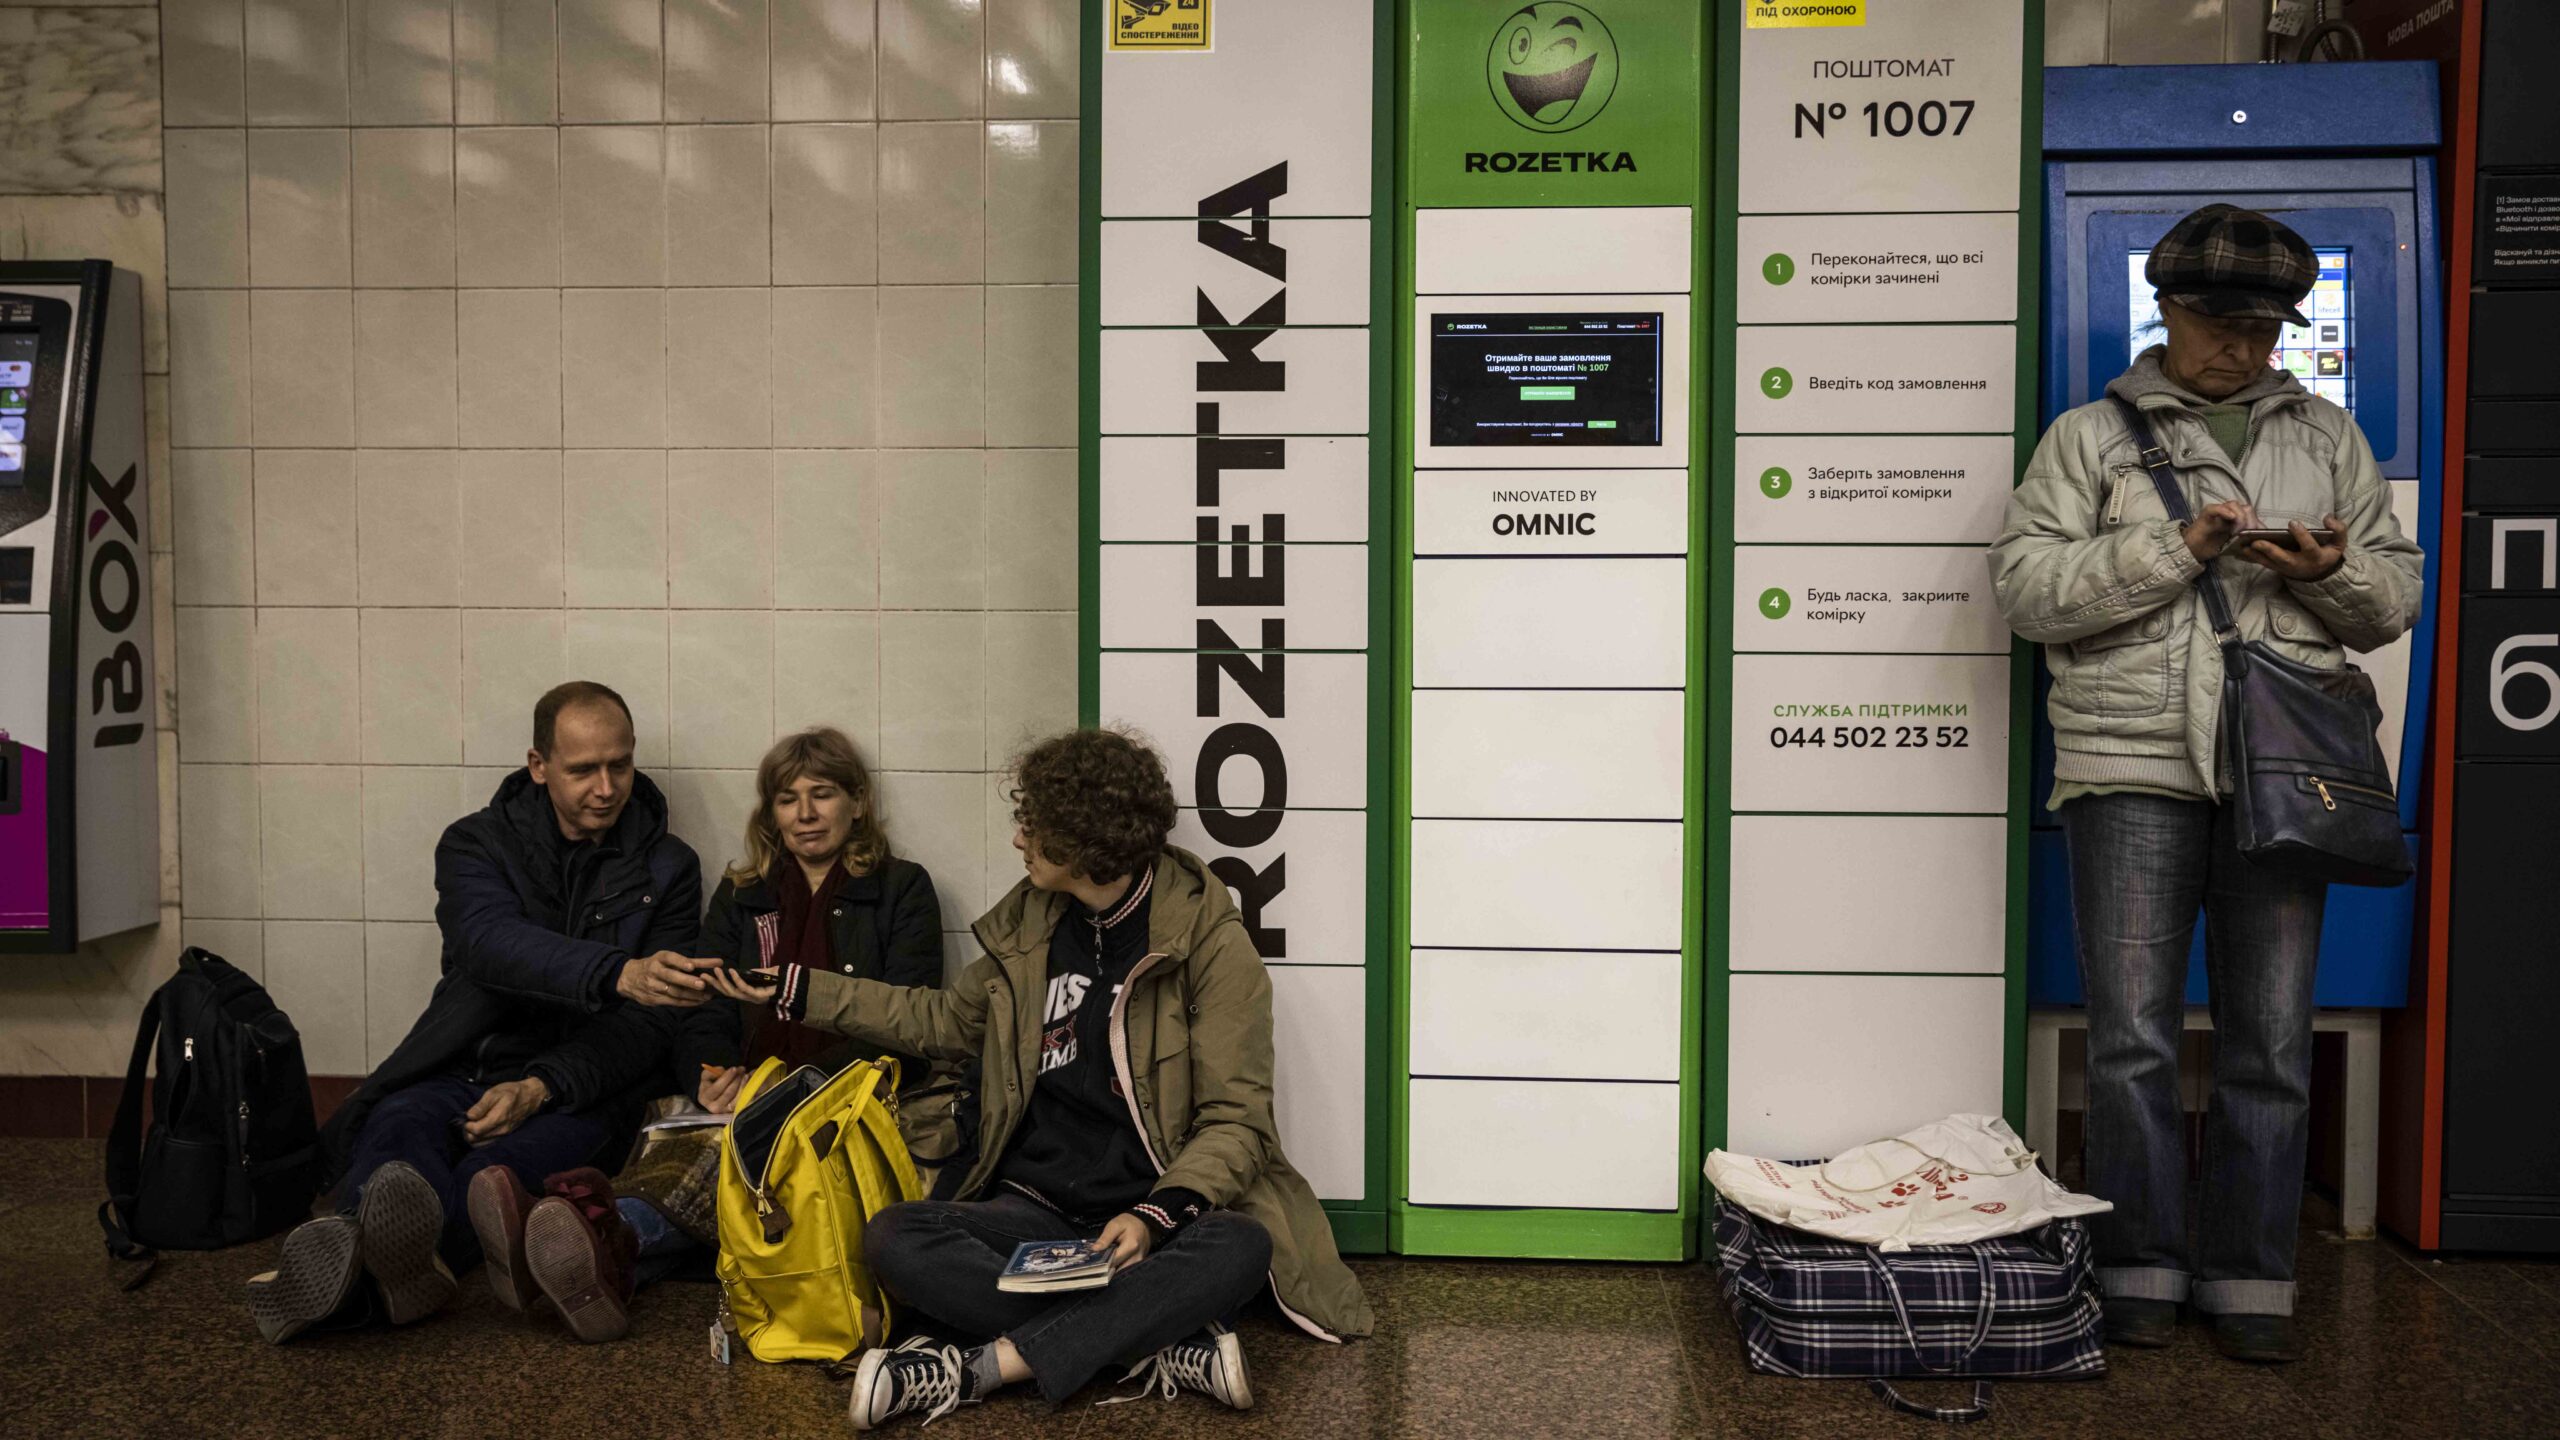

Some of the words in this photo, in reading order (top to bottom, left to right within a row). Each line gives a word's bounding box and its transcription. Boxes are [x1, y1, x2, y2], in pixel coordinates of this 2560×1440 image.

[1756, 7, 1777, 17] ПІД
[1782, 6, 1856, 16] ОХОРОНОЮ
[1121, 31, 1199, 39] СПОСТЕРЕЖЕННЯ
[1172, 23, 1199, 31] ВІДЕО
[2387, 19, 2414, 47] НОВА
[1813, 58, 1955, 79] ПОШТОМАТ
[1863, 100, 1975, 137] 1007
[1465, 151, 1637, 173] ROZETKA
[1811, 251, 1931, 269] Переконайтеся,
[1936, 254, 1959, 265] що
[1962, 250, 1984, 264] всі
[1811, 271, 1871, 288] комірки
[1875, 270, 1940, 285] зачинені
[1485, 354, 1533, 363] Отримайте
[1487, 365, 1520, 373] швидко
[1530, 364, 1575, 372] поштоматі
[1771, 376, 1782, 389] 2
[1809, 376, 1864, 391] Введіть
[1867, 379, 1894, 391] код
[1898, 379, 1987, 390] замовлення
[1770, 476, 1781, 489] 3
[1876, 469, 1965, 480] замовлення
[1493, 490, 1576, 502] INNOVATED
[1580, 490, 1597, 501] BY
[1808, 489, 1816, 499] з
[1820, 485, 1889, 503] відкритої
[1892, 486, 1952, 502] комірки
[1492, 512, 1596, 536] OMNIC
[1196, 159, 1288, 958] ROZETKA
[1769, 597, 1780, 609] 4
[1807, 588, 1841, 604] Будь
[1844, 591, 1892, 603] ласка,
[1807, 607, 1866, 624] комірку
[1773, 704, 1854, 718] СЛУЖБА
[1858, 703, 1969, 719] ПІДТРИМКИ
[1770, 726, 1826, 749] 044
[1833, 726, 1887, 749] 502
[1895, 726, 1929, 748] 23
[1935, 726, 1969, 748] 52
